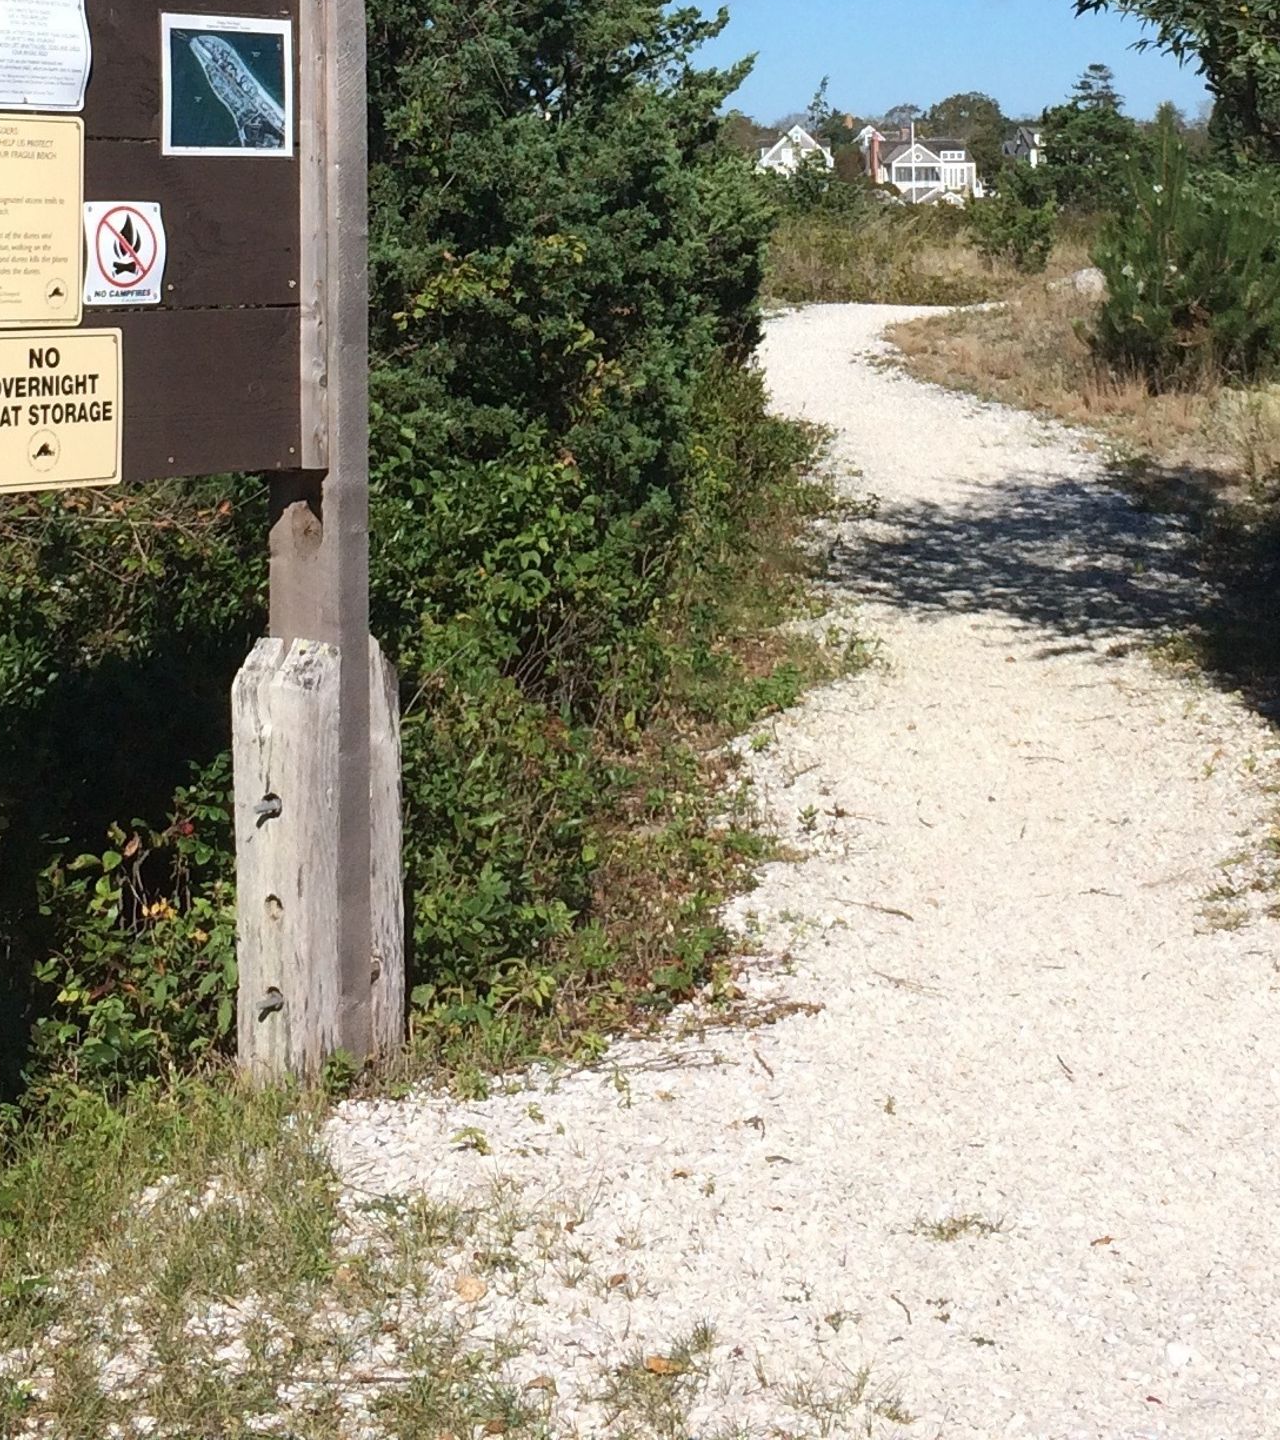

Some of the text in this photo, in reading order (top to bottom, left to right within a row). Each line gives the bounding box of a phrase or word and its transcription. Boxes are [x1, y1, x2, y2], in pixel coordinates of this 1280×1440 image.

[94, 289, 151, 298] NO CAMPFIRES
[29, 347, 60, 369] NO
[28, 401, 113, 426] STORAGE
